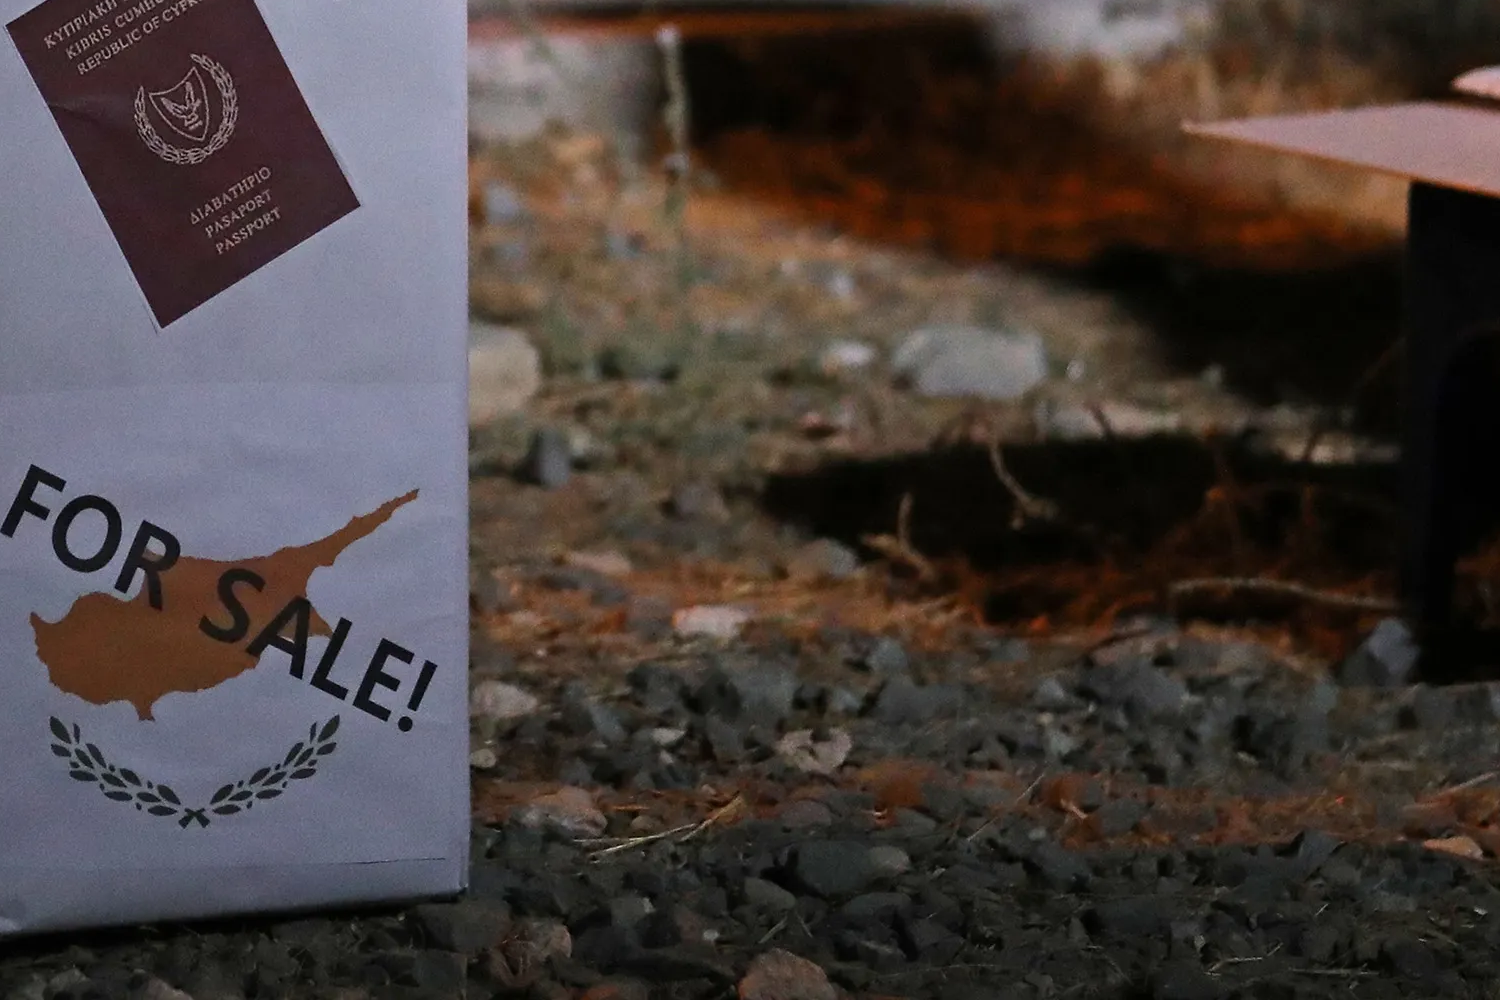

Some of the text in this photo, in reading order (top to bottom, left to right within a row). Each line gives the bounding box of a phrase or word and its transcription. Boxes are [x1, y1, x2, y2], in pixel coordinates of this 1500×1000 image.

[65, 24, 112, 60] KIBRIS
[77, 28, 142, 75] REPUBLIC
[142, 16, 161, 34] OF
[205, 188, 272, 238] PASAPORT
[215, 206, 281, 255] PASSPORT
[0, 463, 182, 612] FOR
[198, 568, 438, 733] SALE!
